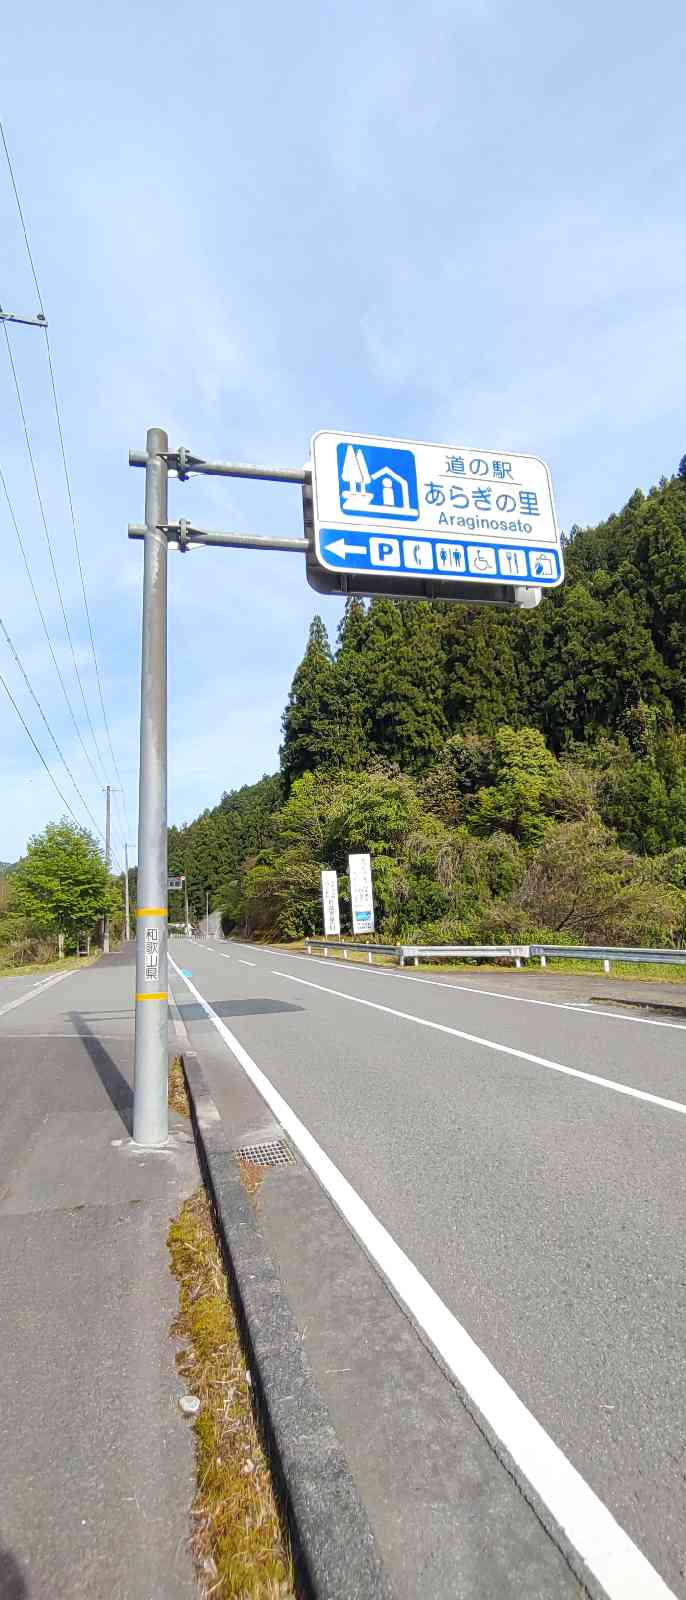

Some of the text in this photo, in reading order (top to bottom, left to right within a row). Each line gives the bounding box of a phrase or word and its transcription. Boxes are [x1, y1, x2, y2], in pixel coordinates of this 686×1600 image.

[445, 455, 514, 480] 道の駅
[424, 481, 541, 516] あらぎの里
[438, 511, 533, 534] Araginosato
[378, 543, 393, 561] P
[145, 928, 159, 981] 和歌山県
